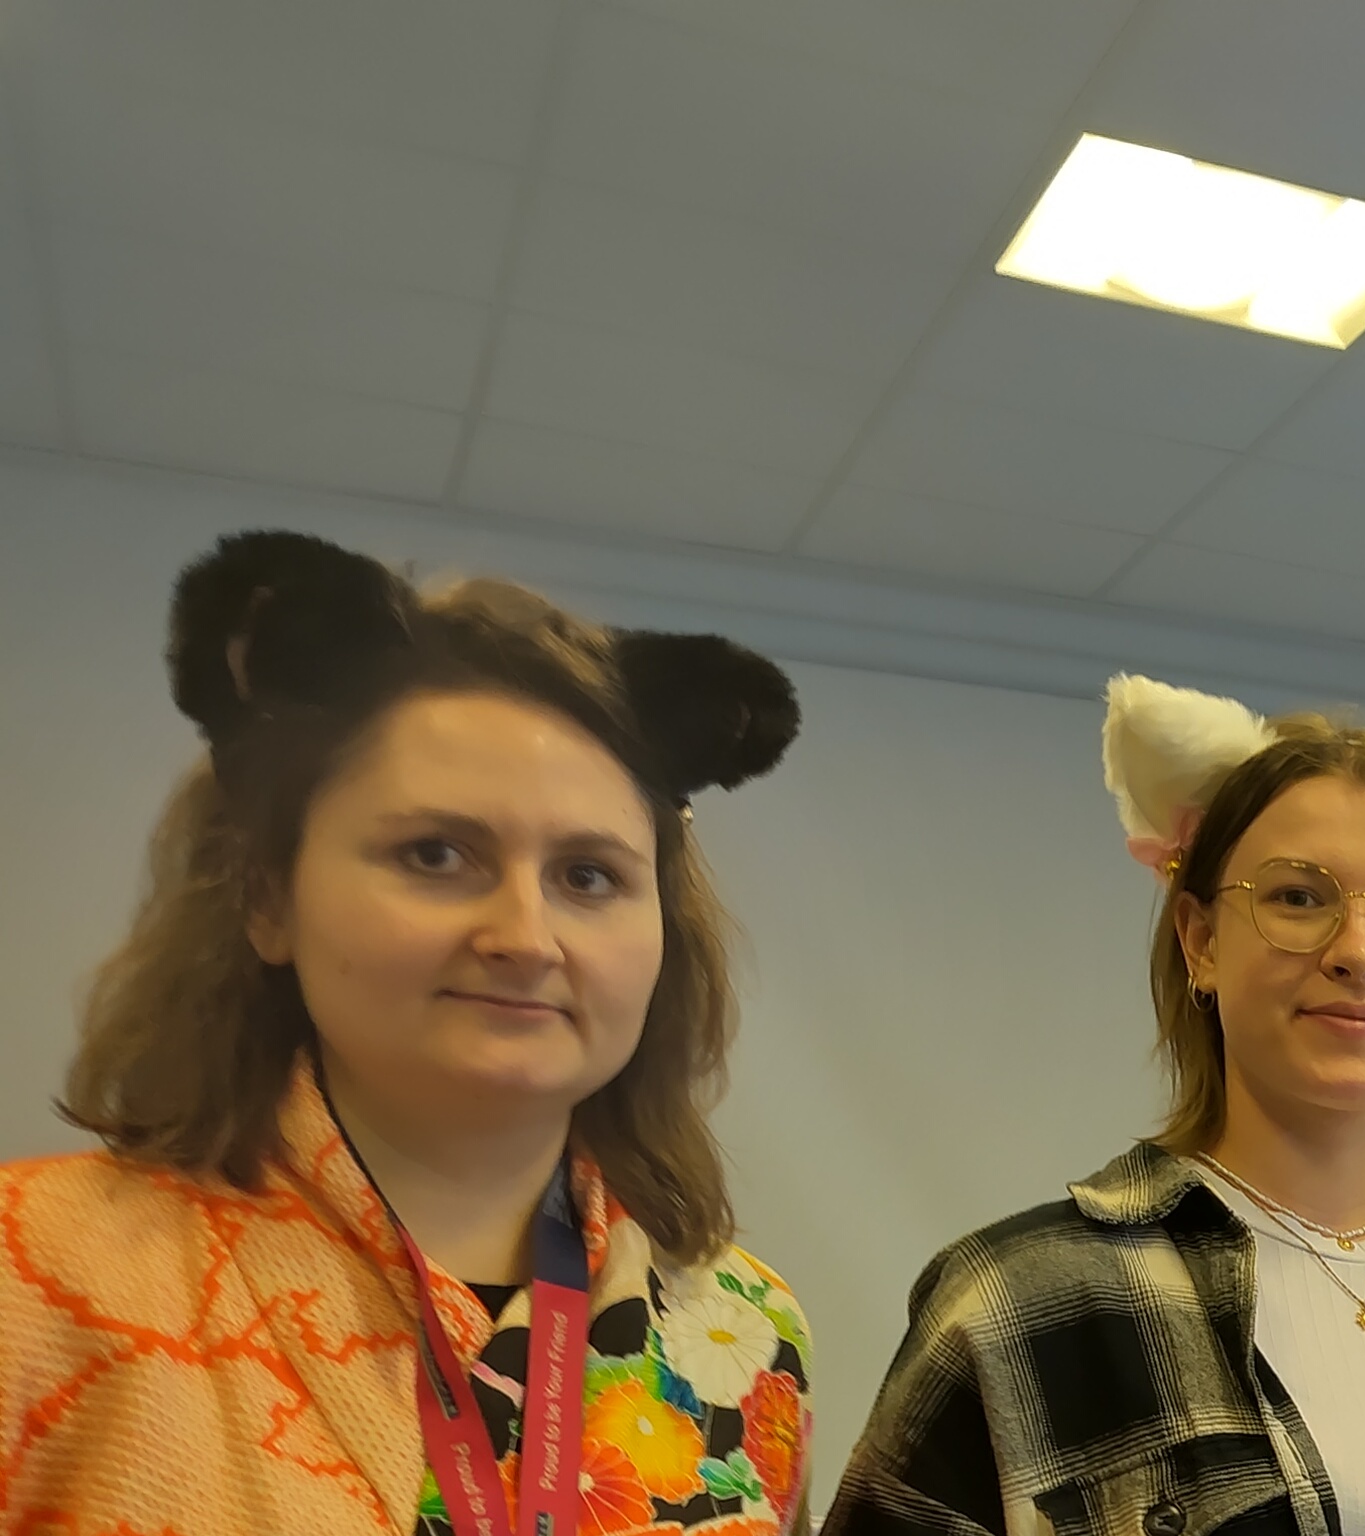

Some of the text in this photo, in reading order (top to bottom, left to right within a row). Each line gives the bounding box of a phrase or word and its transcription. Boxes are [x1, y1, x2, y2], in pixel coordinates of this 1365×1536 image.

[548, 1310, 569, 1363] Friend
[545, 1365, 564, 1400] Your
[542, 1424, 559, 1442] to
[539, 1442, 560, 1492] Proud
